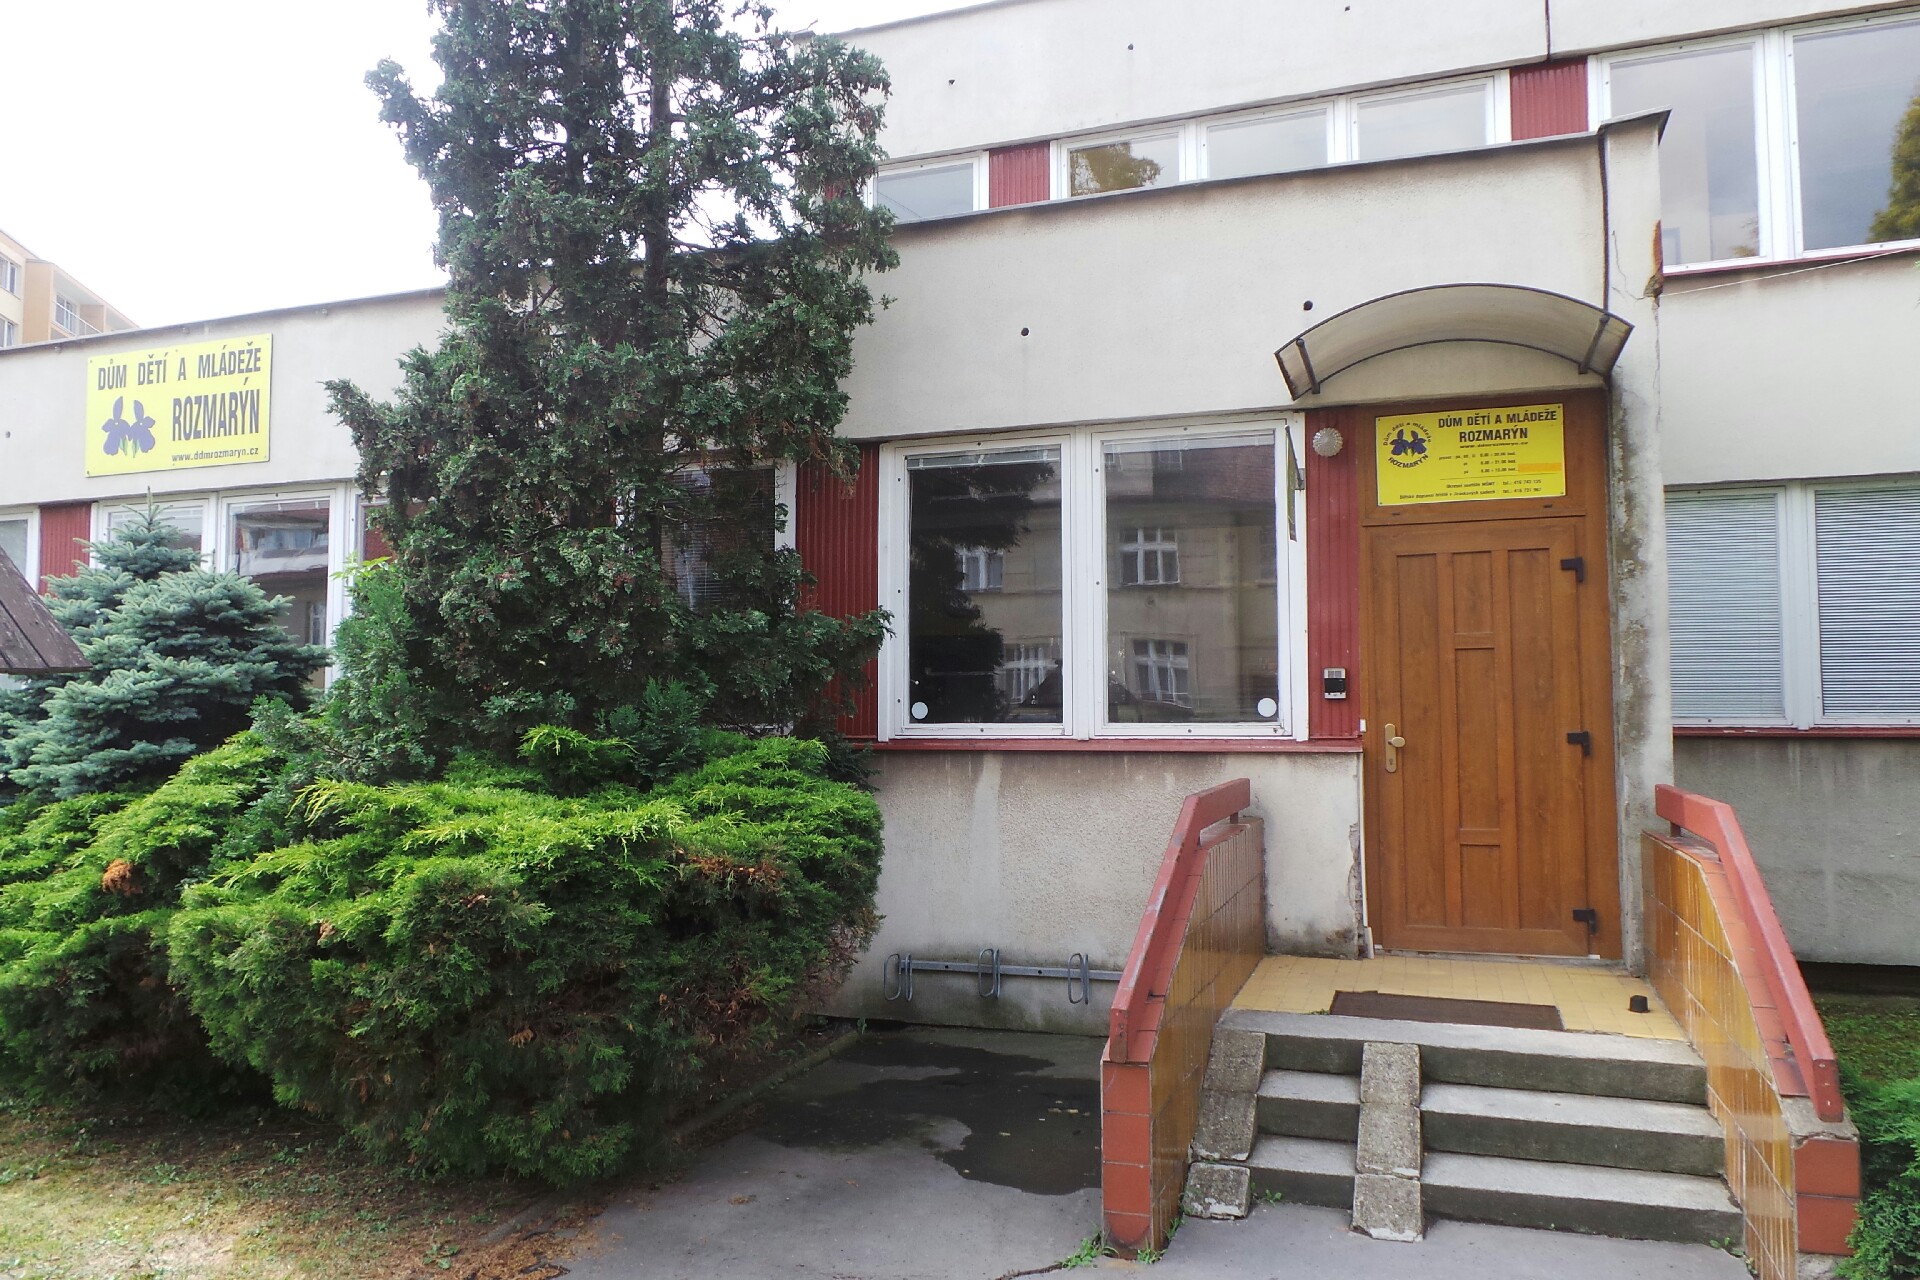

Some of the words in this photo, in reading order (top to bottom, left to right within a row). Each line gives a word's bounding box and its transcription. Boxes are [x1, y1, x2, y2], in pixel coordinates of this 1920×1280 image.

[98, 358, 127, 391] DŮM
[138, 352, 168, 386] DĚTÍ
[177, 357, 187, 381] A
[198, 341, 262, 379] MLÁDEŽE
[172, 377, 260, 442] ROZMARÝN
[1438, 415, 1463, 429] DŮM
[1467, 412, 1491, 426] DĚTÍ
[1494, 412, 1503, 424] A
[1506, 409, 1557, 423] MLÁDEŽE
[1459, 425, 1529, 443] ROZMARÝN
[171, 447, 259, 462] www.ddmrozmaryn.cz
